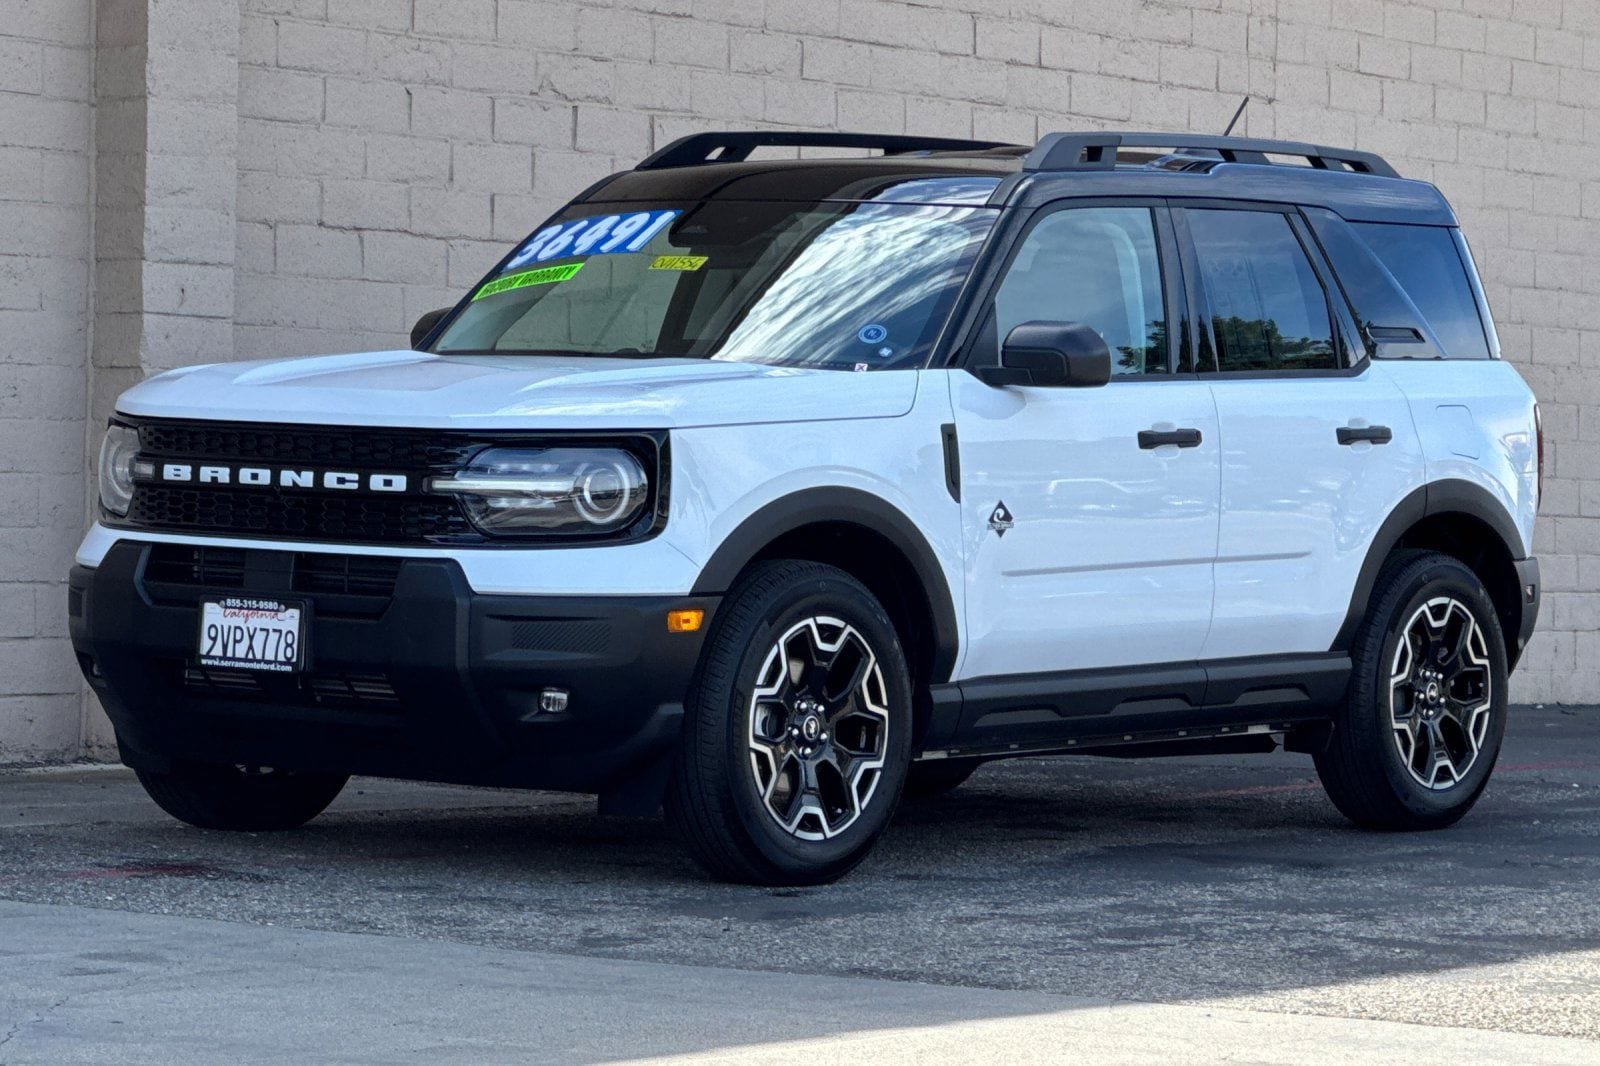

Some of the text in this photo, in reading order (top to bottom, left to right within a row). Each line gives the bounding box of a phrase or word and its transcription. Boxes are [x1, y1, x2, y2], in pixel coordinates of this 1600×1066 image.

[507, 211, 675, 269] 36491
[163, 464, 407, 492] BRONCO
[223, 607, 285, 624] California
[206, 624, 296, 661] 9VPX778
